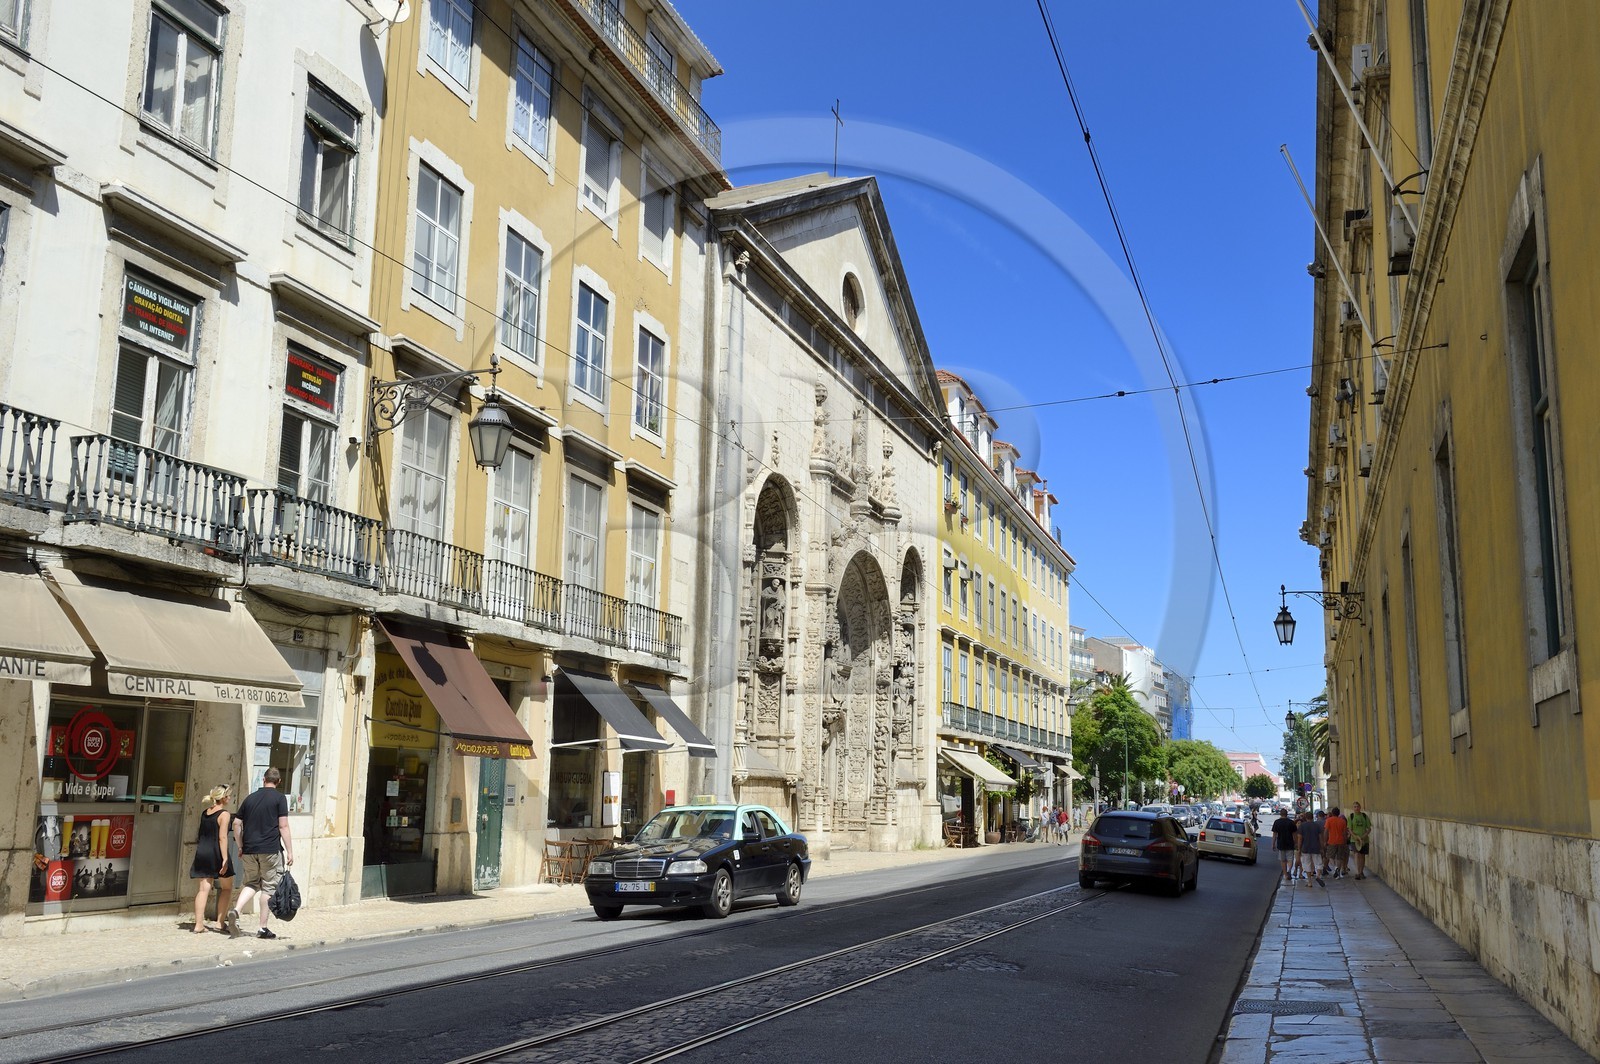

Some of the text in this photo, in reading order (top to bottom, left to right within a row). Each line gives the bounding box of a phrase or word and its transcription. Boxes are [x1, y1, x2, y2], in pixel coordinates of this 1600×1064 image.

[128, 281, 190, 316] CÂMARAS VIGILÂNCIA
[134, 296, 184, 324] GRAVAÇÃO DIGITAL
[139, 321, 175, 342] VIA INTERNET
[0, 656, 46, 677] ANTE
[125, 675, 196, 696] CENTRAL
[214, 685, 233, 699] Tel.
[56, 783, 116, 799] A Vida é Super
